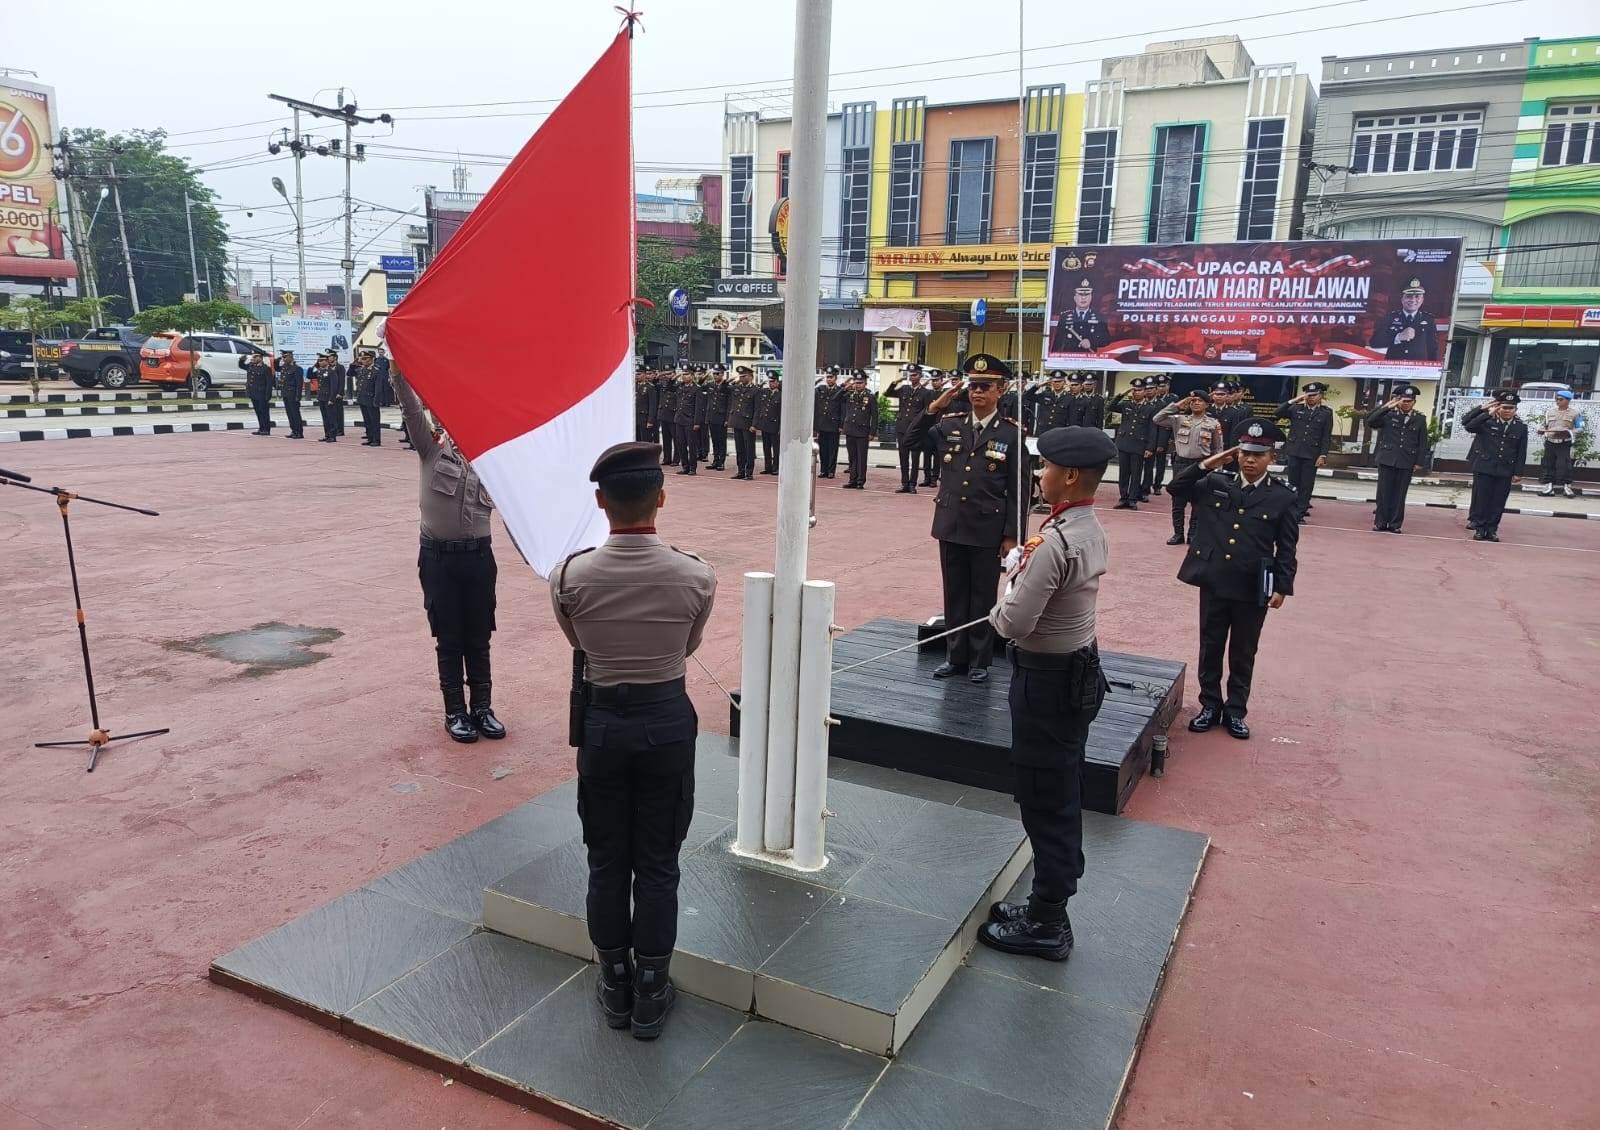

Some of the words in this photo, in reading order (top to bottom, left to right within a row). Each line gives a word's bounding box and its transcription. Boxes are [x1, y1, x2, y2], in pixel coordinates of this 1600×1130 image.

[0, 110, 26, 157] 6
[385, 258, 410, 266] vivo
[949, 252, 991, 264] Always
[994, 251, 1018, 262] Low
[1197, 261, 1285, 275] UPACARA
[717, 283, 733, 293] CW
[1118, 278, 1218, 300] PERINGATAN
[1222, 277, 1265, 300] HARI
[1268, 277, 1371, 300] PAHLAWAN
[1123, 314, 1169, 322] POLRES
[1174, 314, 1235, 323] SANGGAU
[1250, 314, 1295, 323] POLDA
[1300, 315, 1356, 324] KALBAR
[36, 346, 61, 359] POLISI
